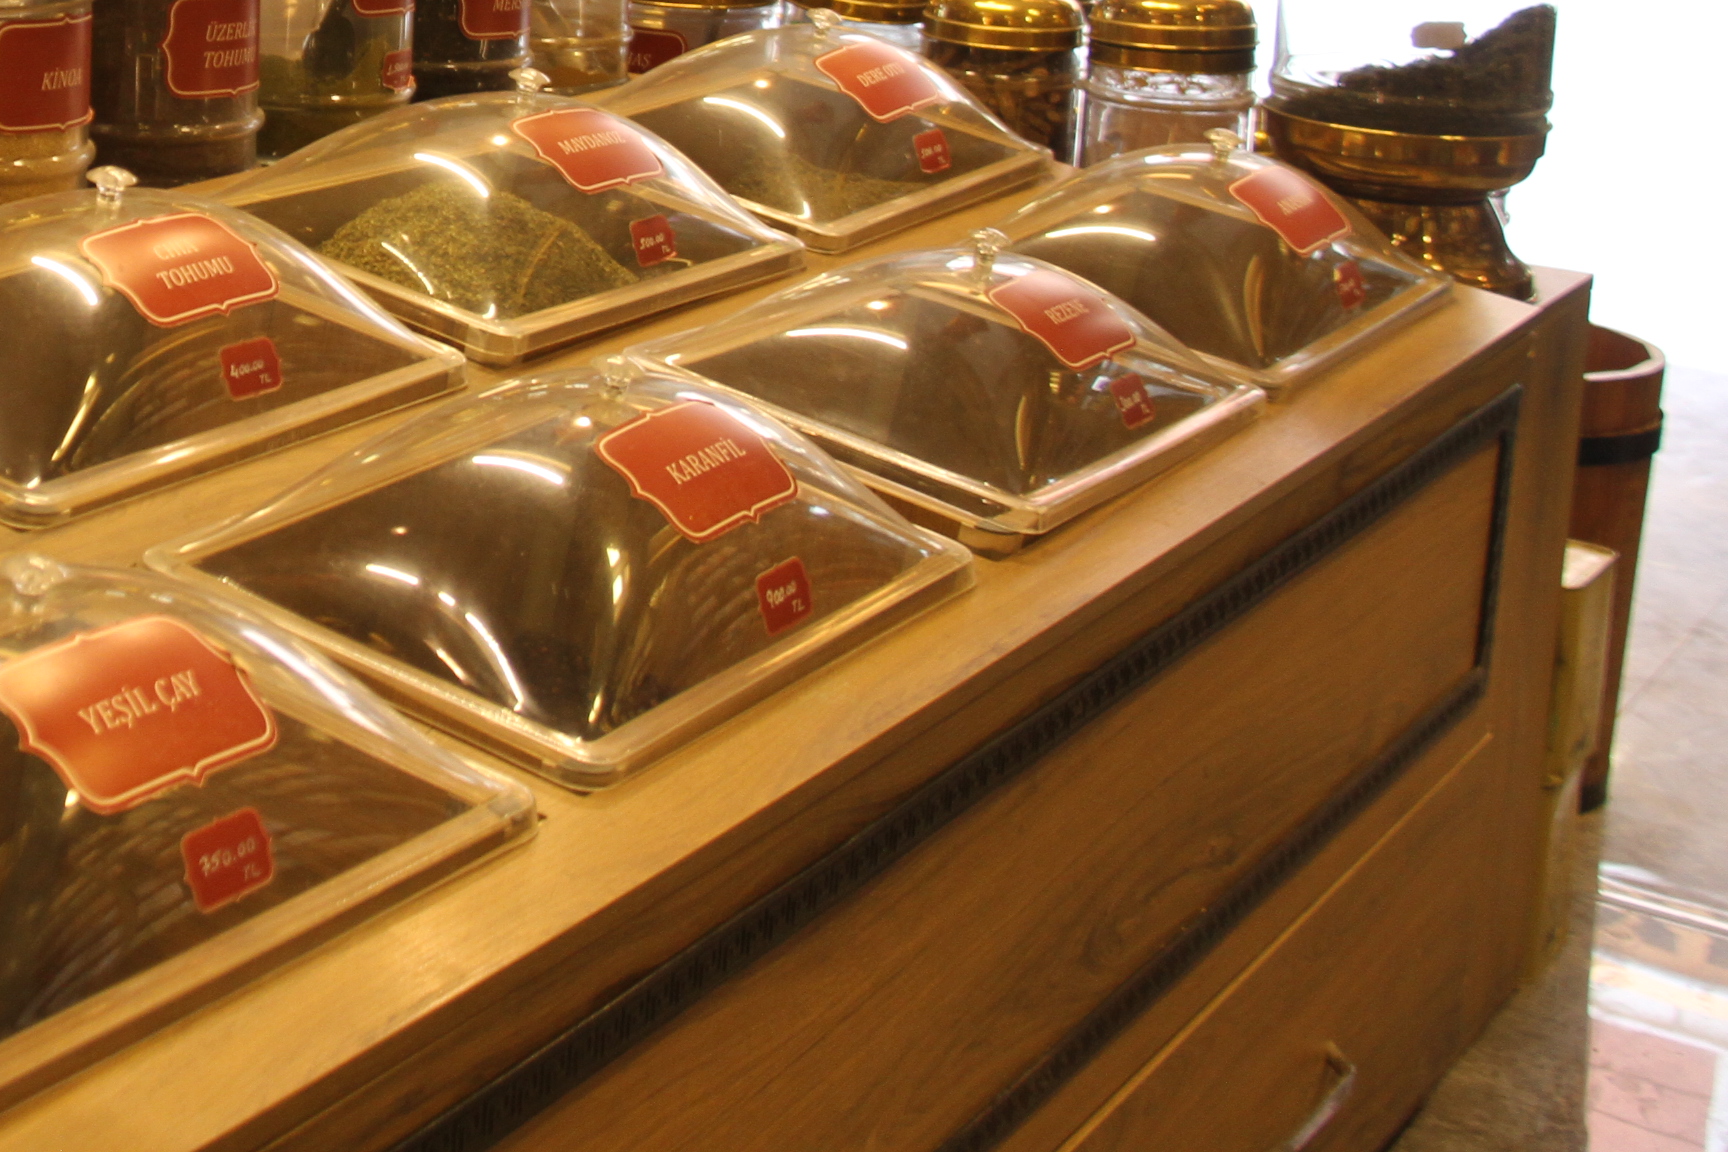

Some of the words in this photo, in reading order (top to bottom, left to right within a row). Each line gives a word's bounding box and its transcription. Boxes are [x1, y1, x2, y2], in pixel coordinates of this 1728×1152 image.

[40, 64, 83, 92] KİNOA
[856, 68, 888, 88] DERE
[557, 129, 626, 156] MAYDANOZ
[156, 255, 235, 289] TOHUMU
[1043, 299, 1090, 326] REZENE
[665, 437, 747, 485] KARANFİL
[791, 599, 806, 614] TL
[77, 685, 157, 735] YEŞİL
[153, 668, 202, 712] ÇAY
